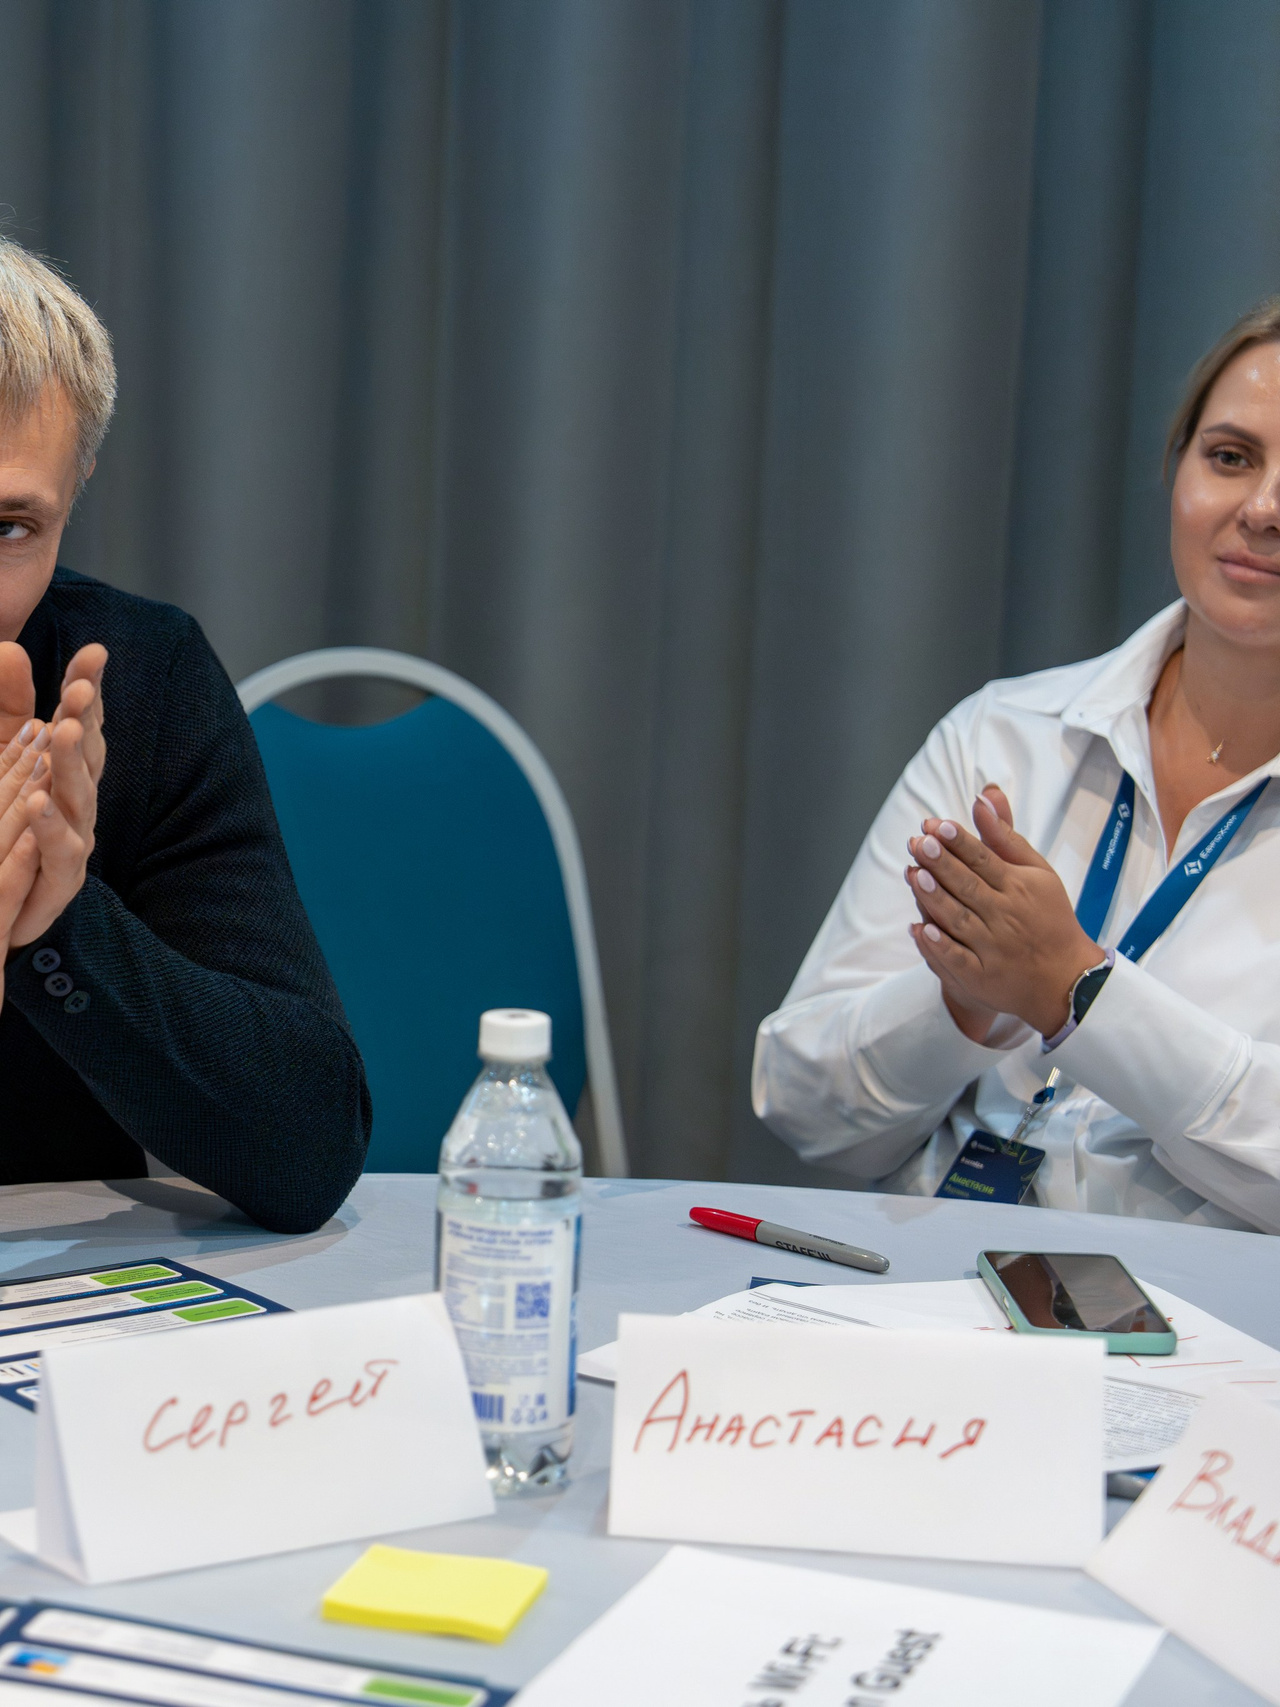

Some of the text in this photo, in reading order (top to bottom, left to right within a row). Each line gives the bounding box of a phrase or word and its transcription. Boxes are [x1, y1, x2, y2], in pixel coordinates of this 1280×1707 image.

[143, 1359, 399, 1453] Сергей
[1167, 1448, 1280, 1566] Влад
[851, 1628, 940, 1693] Guest
